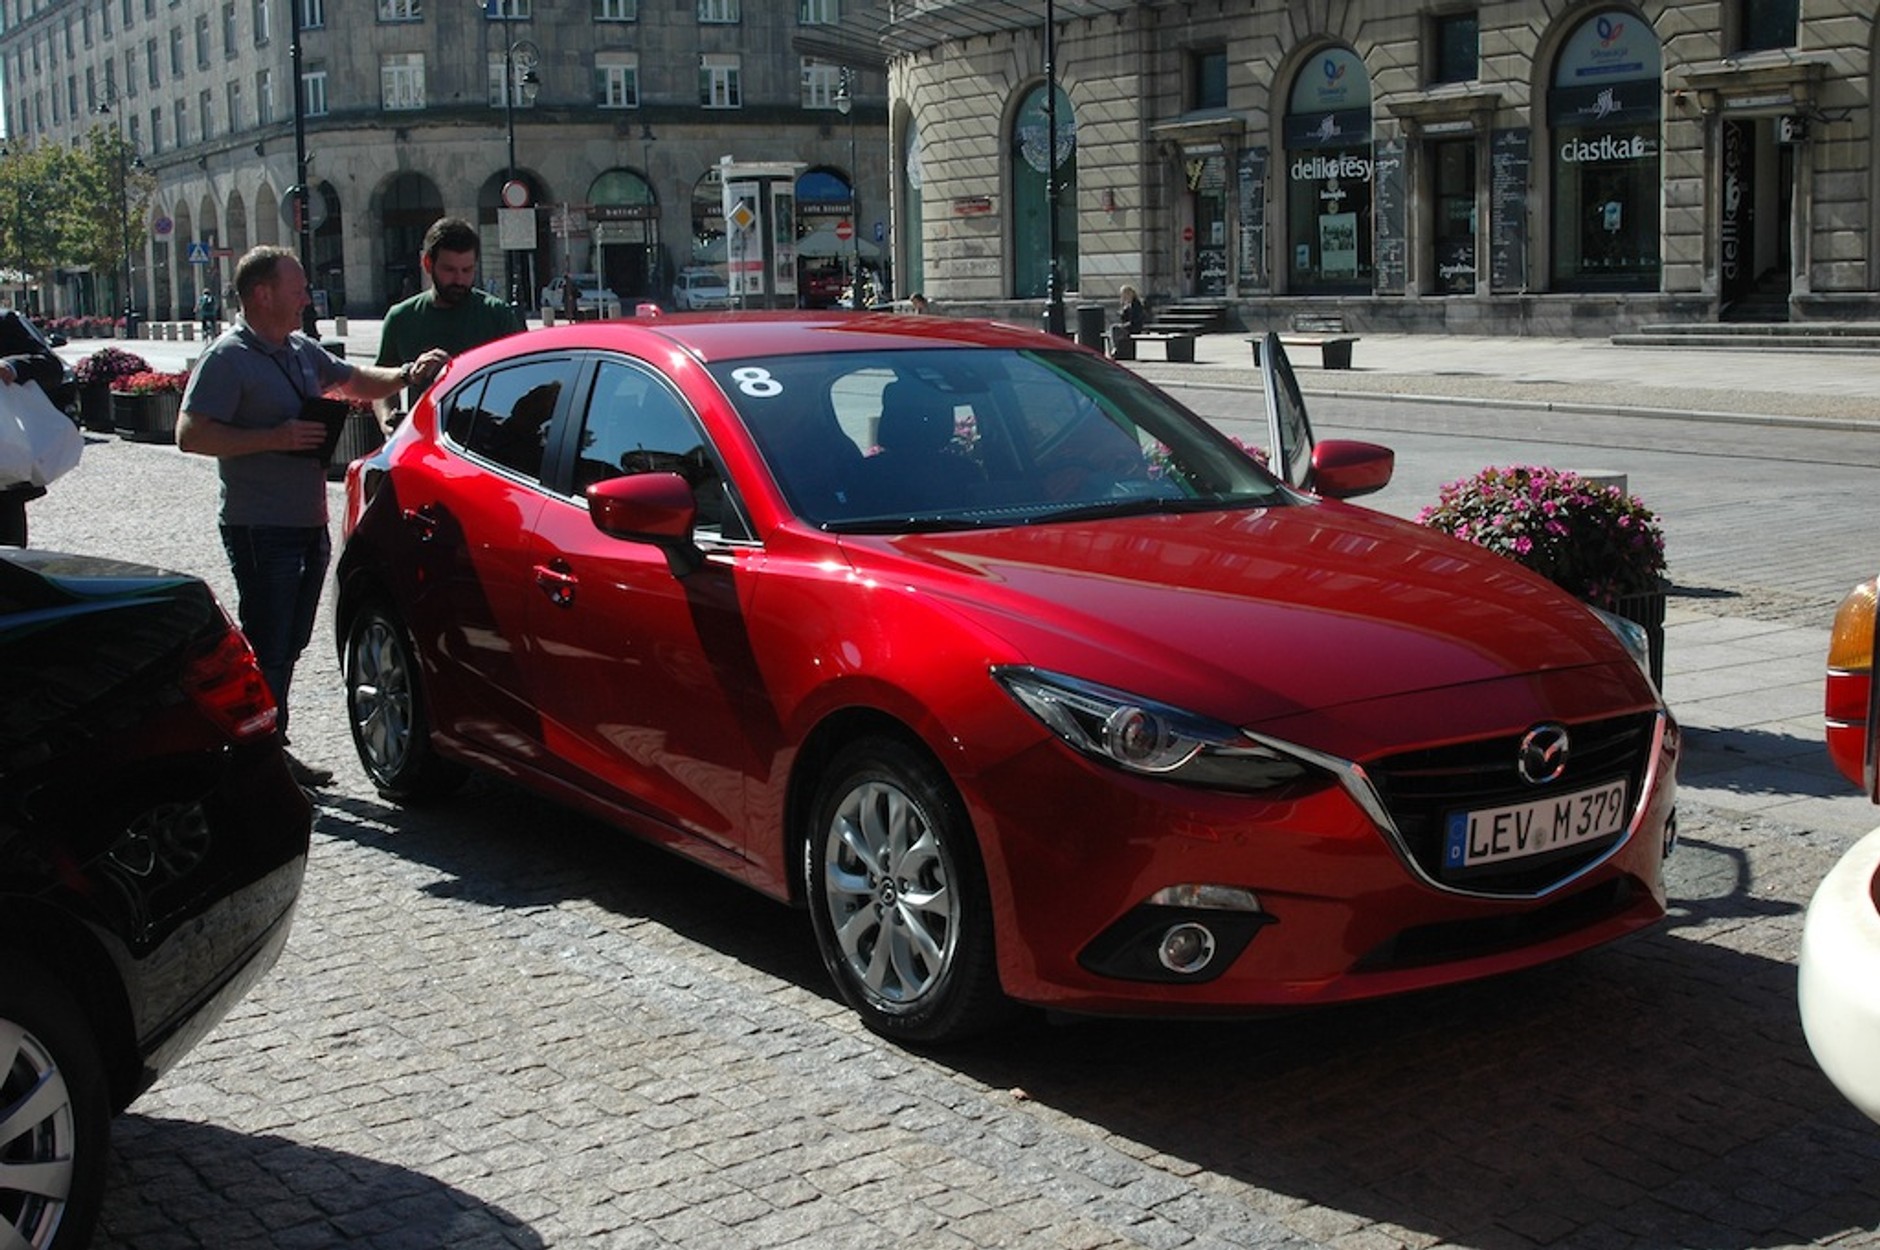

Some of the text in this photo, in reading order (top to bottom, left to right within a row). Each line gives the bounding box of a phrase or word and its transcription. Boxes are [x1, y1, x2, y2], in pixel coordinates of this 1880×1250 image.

[1561, 134, 1630, 161] ciastka
[731, 366, 784, 398] 8
[1468, 787, 1623, 860] LEV M 379
